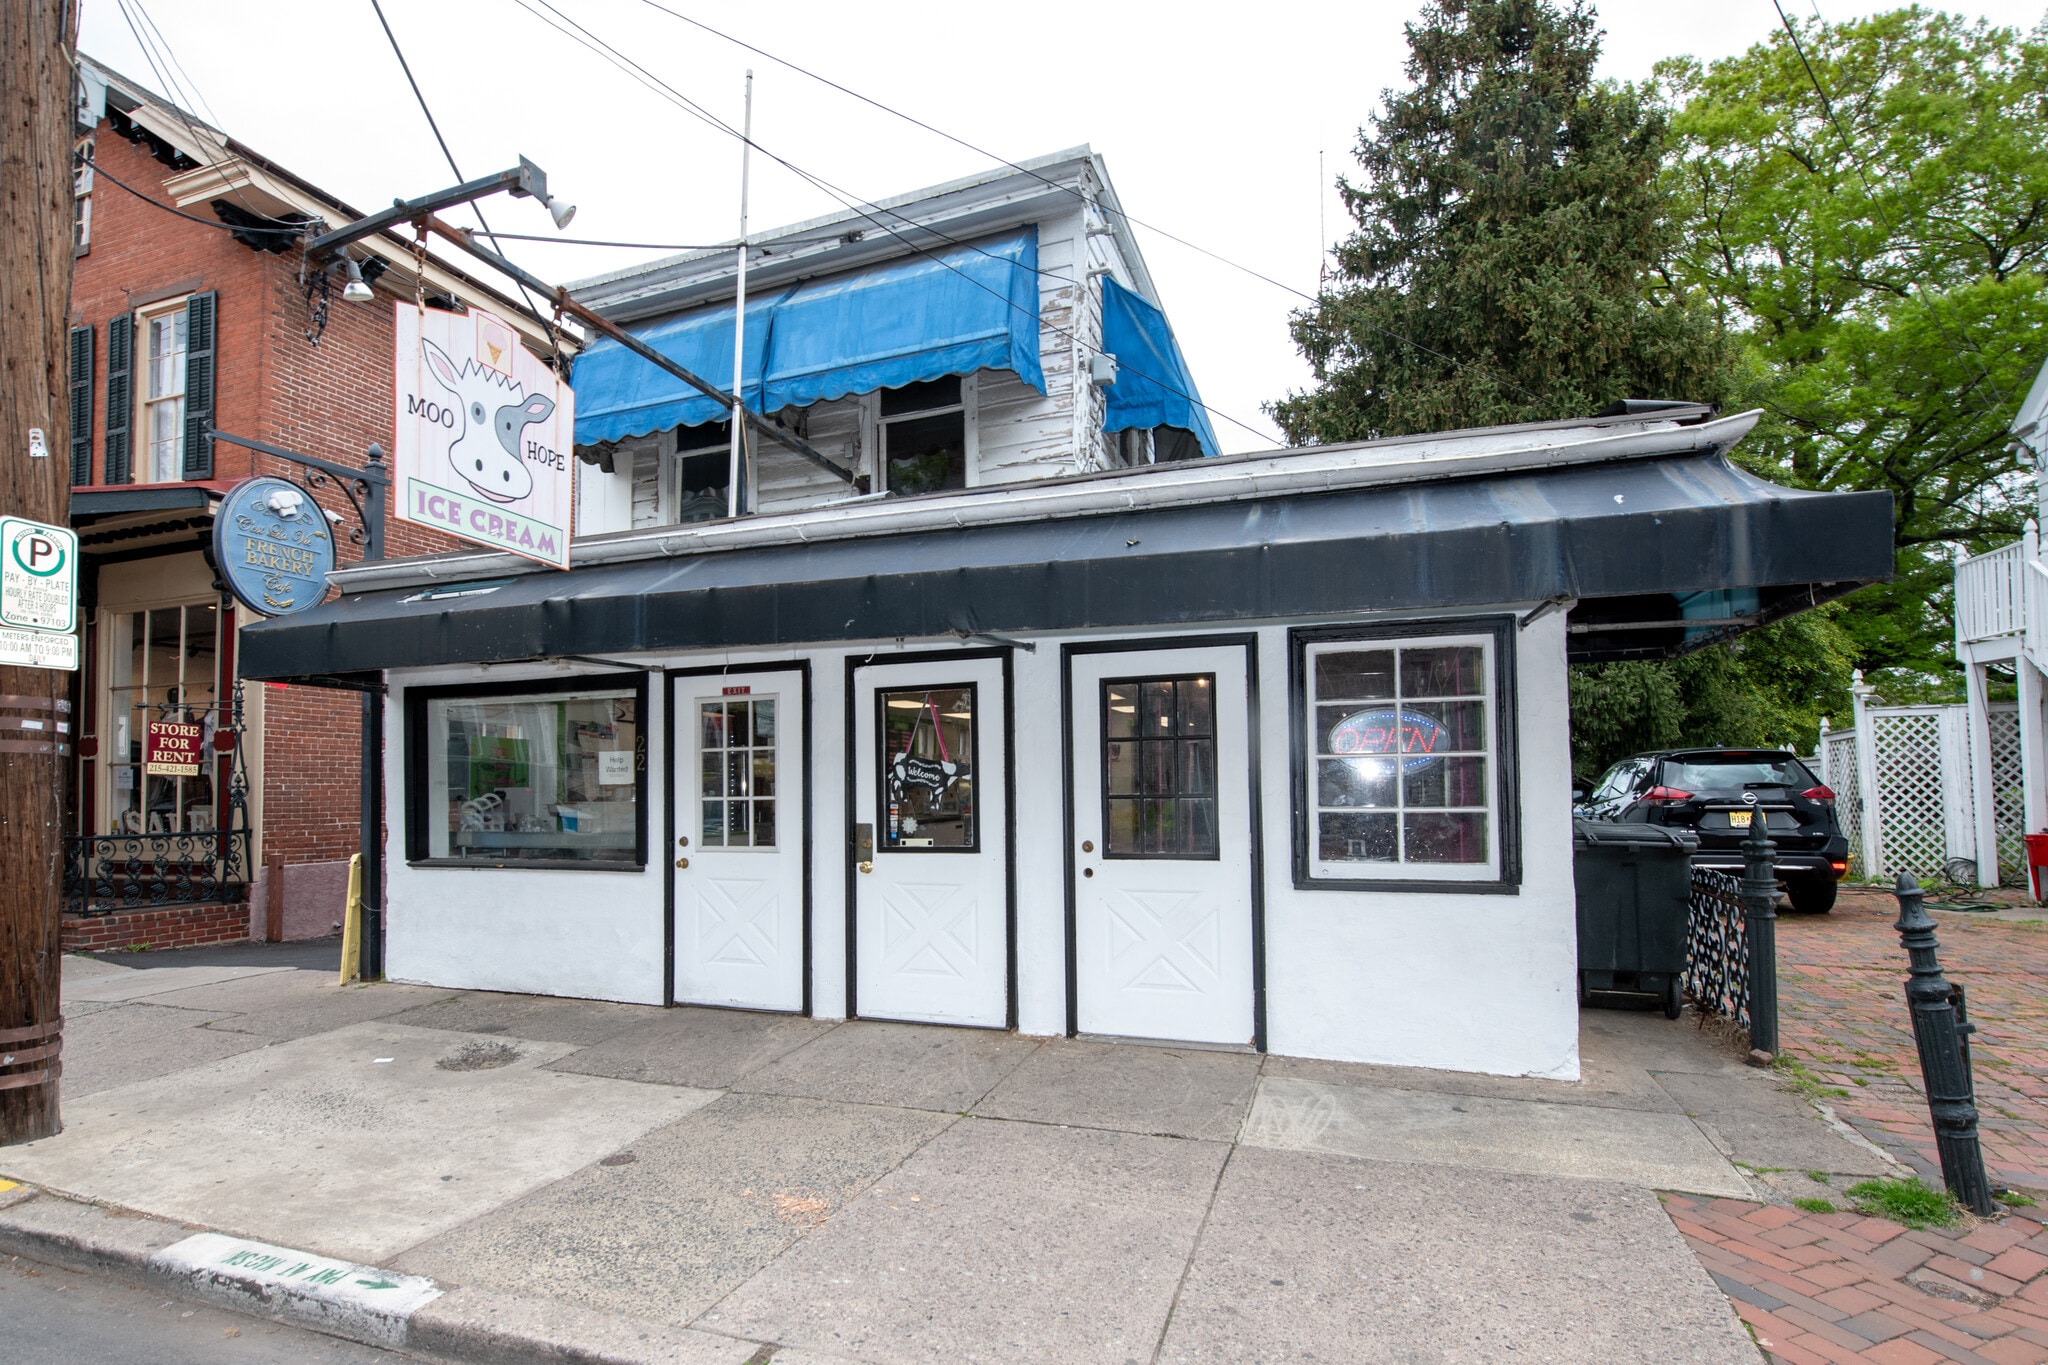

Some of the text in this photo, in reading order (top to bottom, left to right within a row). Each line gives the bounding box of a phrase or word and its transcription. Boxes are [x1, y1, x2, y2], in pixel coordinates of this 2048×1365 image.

[407, 393, 455, 429] MOO
[527, 440, 565, 472] HOPE
[416, 489, 557, 556] ICE CREAM
[30, 537, 53, 567] P
[245, 537, 315, 564] FRENCH
[245, 550, 315, 577] BAKERY
[4, 571, 20, 584] PAY
[28, 575, 38, 586] BY
[45, 578, 70, 592] PLATE
[5, 611, 66, 628] Zone 97103
[2, 631, 69, 645] METERS ENFORCED
[20, 642, 32, 653] AM
[34, 644, 44, 655] TO
[61, 646, 73, 657] PM
[727, 687, 745, 695] EXIT
[150, 722, 199, 737] STORE
[159, 736, 190, 750] FOR
[1335, 726, 1440, 755] OPEN
[152, 750, 195, 763] RENT
[907, 766, 941, 782] Welcome
[220, 1250, 287, 1273] KIOSK
[301, 1268, 353, 1286] PAY
